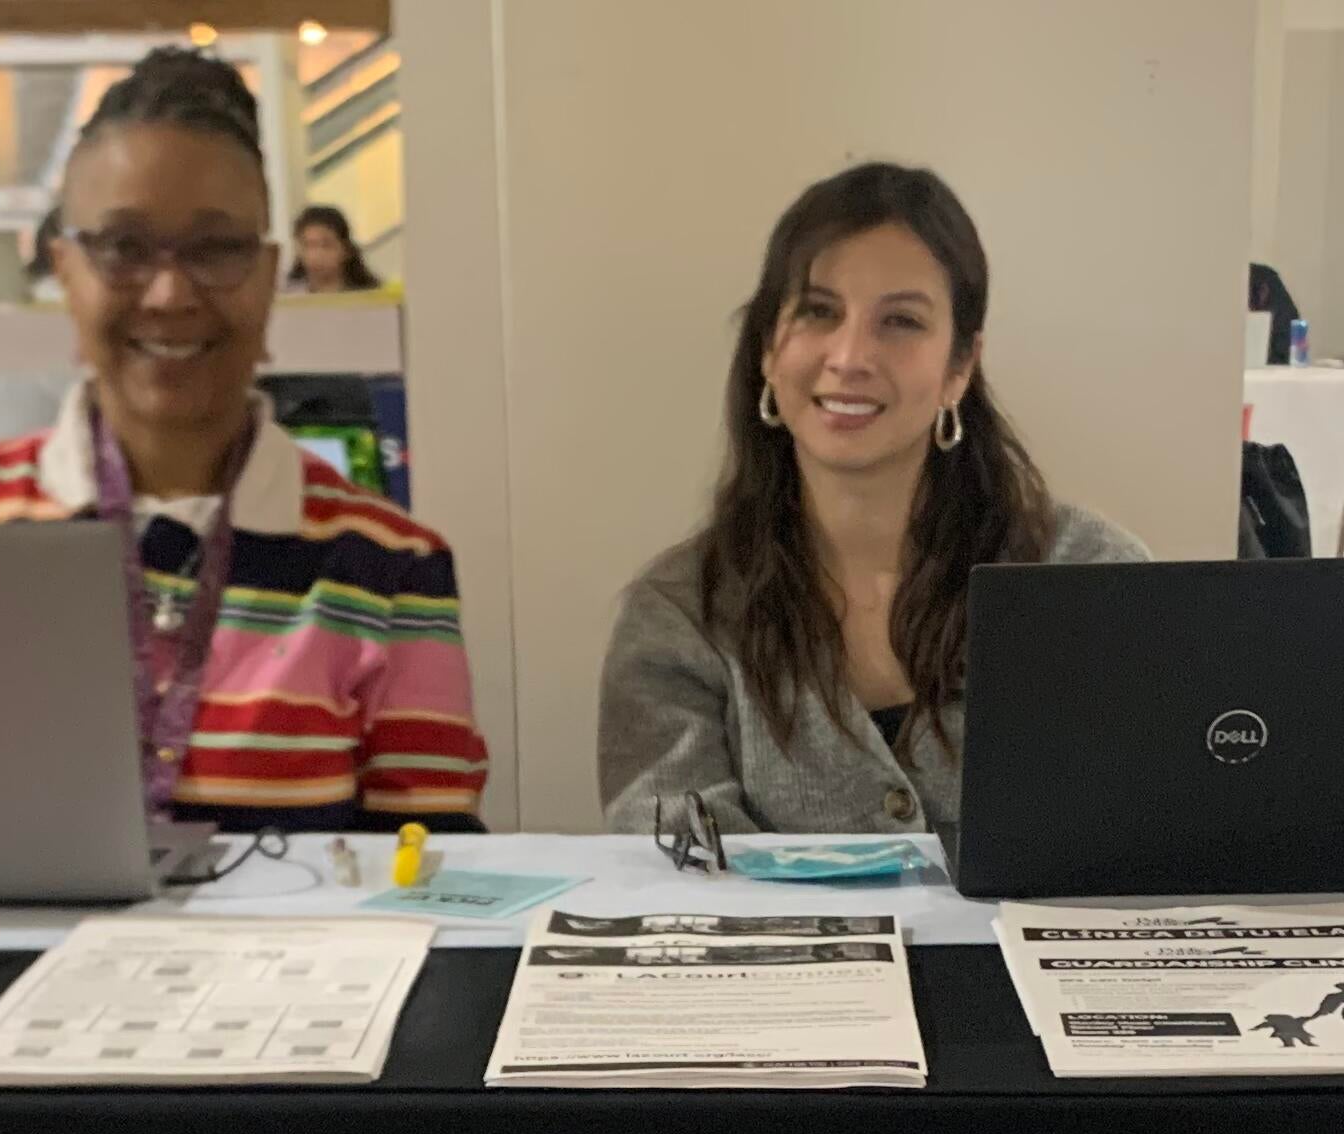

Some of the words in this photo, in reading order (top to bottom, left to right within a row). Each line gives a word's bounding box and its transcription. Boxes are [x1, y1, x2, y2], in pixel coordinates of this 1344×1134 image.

[1040, 928, 1174, 940] CLÍNICA
[1184, 930, 1224, 938] DE
[1049, 960, 1277, 968] GUARDIANSHIP
